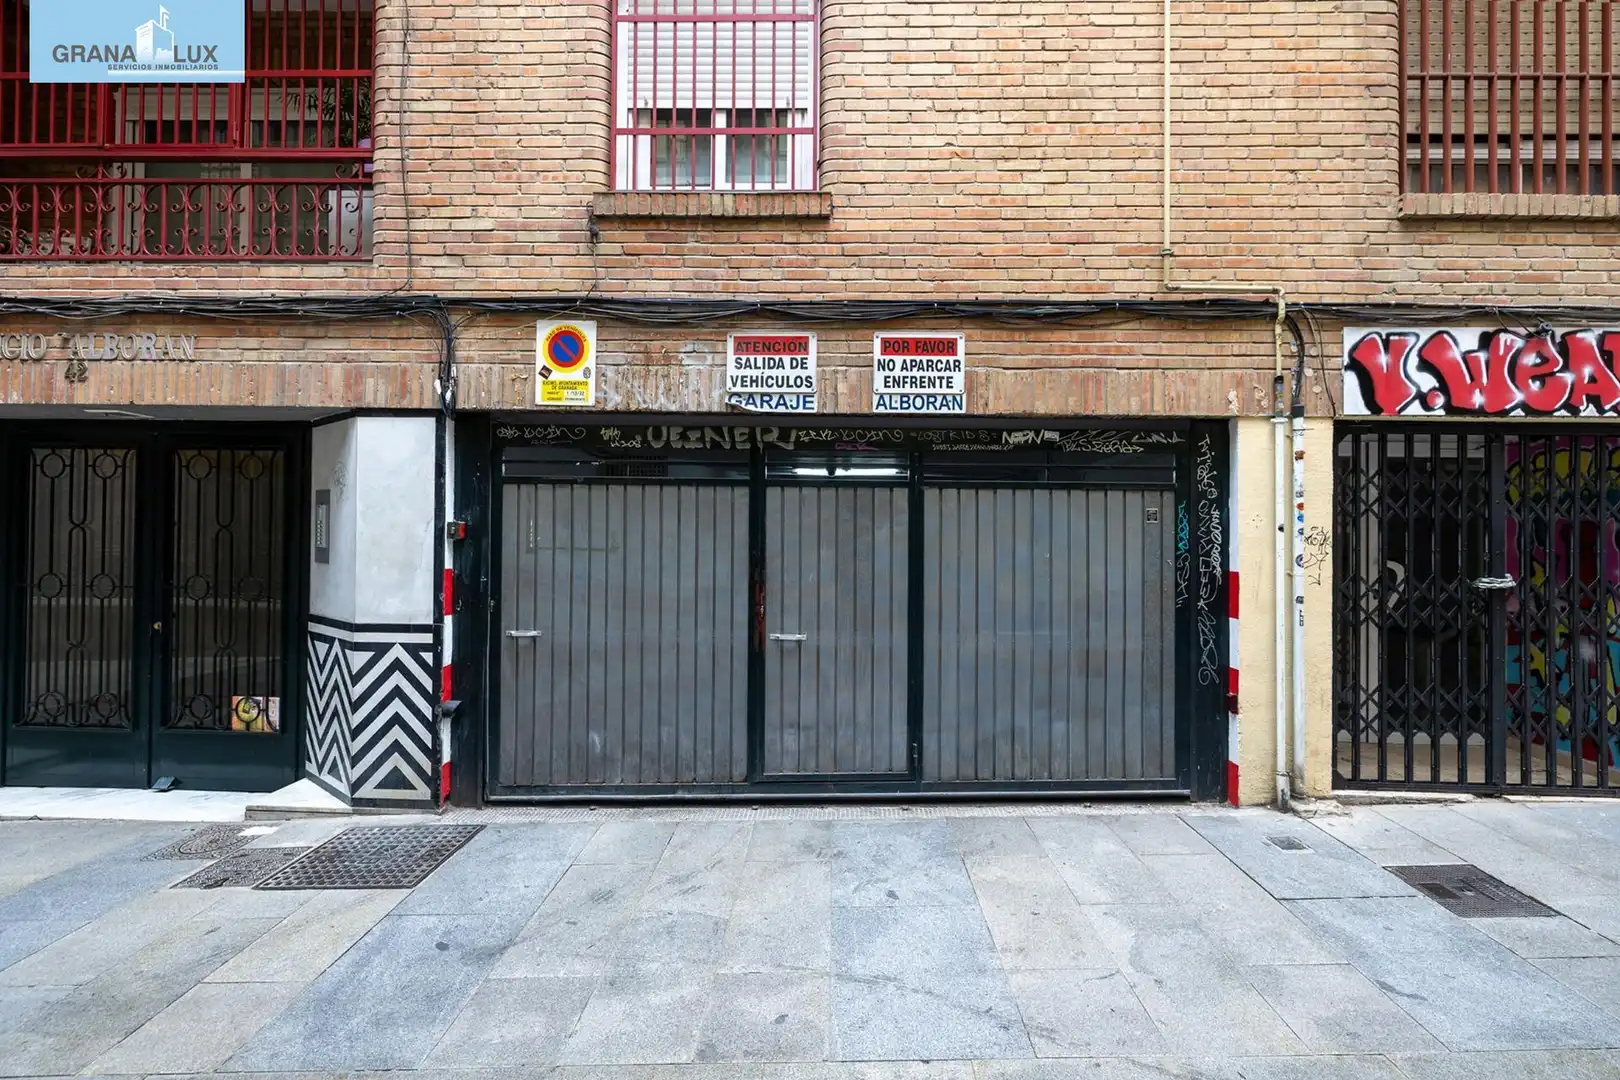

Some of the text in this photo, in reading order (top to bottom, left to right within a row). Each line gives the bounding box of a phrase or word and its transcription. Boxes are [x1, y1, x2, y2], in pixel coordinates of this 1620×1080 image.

[0, 332, 197, 361] CIO ALBORAN
[735, 338, 809, 354] ATENCIÓN
[883, 340, 956, 354] POR FAVOR
[734, 357, 809, 370] SALIDA DE
[877, 358, 962, 373] NO APARCAR
[730, 372, 814, 389] VEHÍCULOS
[883, 375, 954, 389] ENFRENTE
[727, 393, 815, 410] GARAJE
[875, 394, 963, 411] ALBORAN
